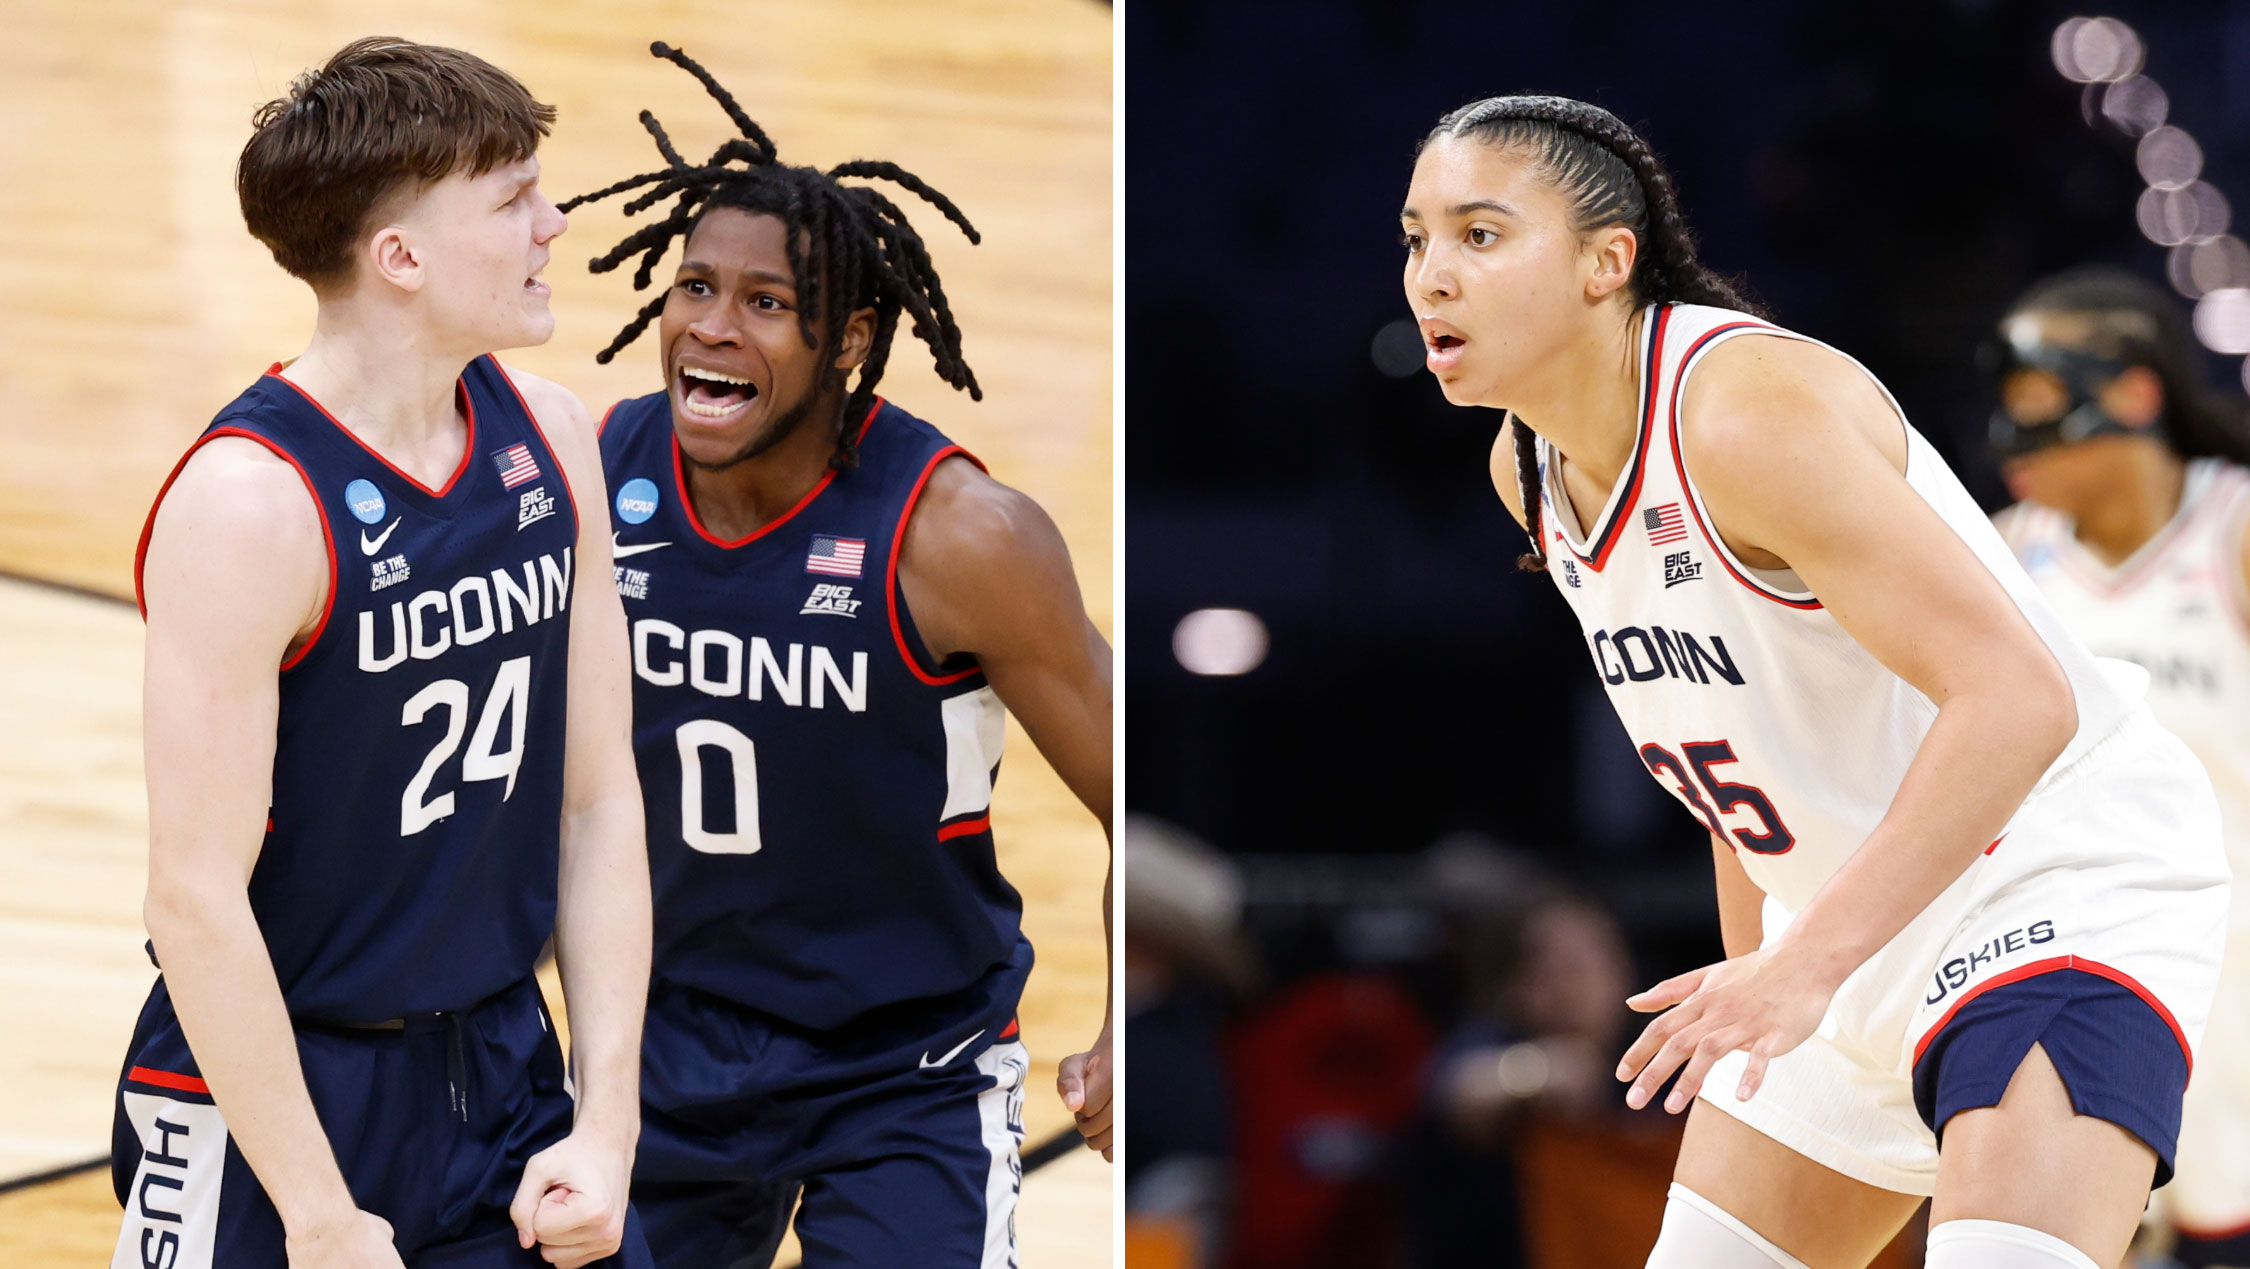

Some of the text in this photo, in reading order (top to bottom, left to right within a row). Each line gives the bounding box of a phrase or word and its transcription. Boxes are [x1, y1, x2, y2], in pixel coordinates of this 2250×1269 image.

[353, 498, 384, 515] NCAA
[520, 486, 545, 509] BIG
[620, 498, 656, 513] NCAA
[519, 497, 555, 523] EAST
[372, 554, 408, 577] BE THE
[1665, 550, 1690, 568] BIG
[371, 566, 411, 592] CHANGE
[625, 569, 650, 586] THE
[1665, 562, 1702, 581] EAST
[617, 581, 648, 600] ANGE
[811, 583, 854, 599] BIG
[358, 546, 571, 674] UCONN
[804, 596, 863, 613] EAST
[633, 618, 868, 713] CONN
[1594, 626, 1746, 686] CONN
[400, 655, 531, 837] 24
[675, 718, 762, 855] 0
[1640, 738, 1796, 855] 35
[1926, 919, 2055, 1006] USKIES
